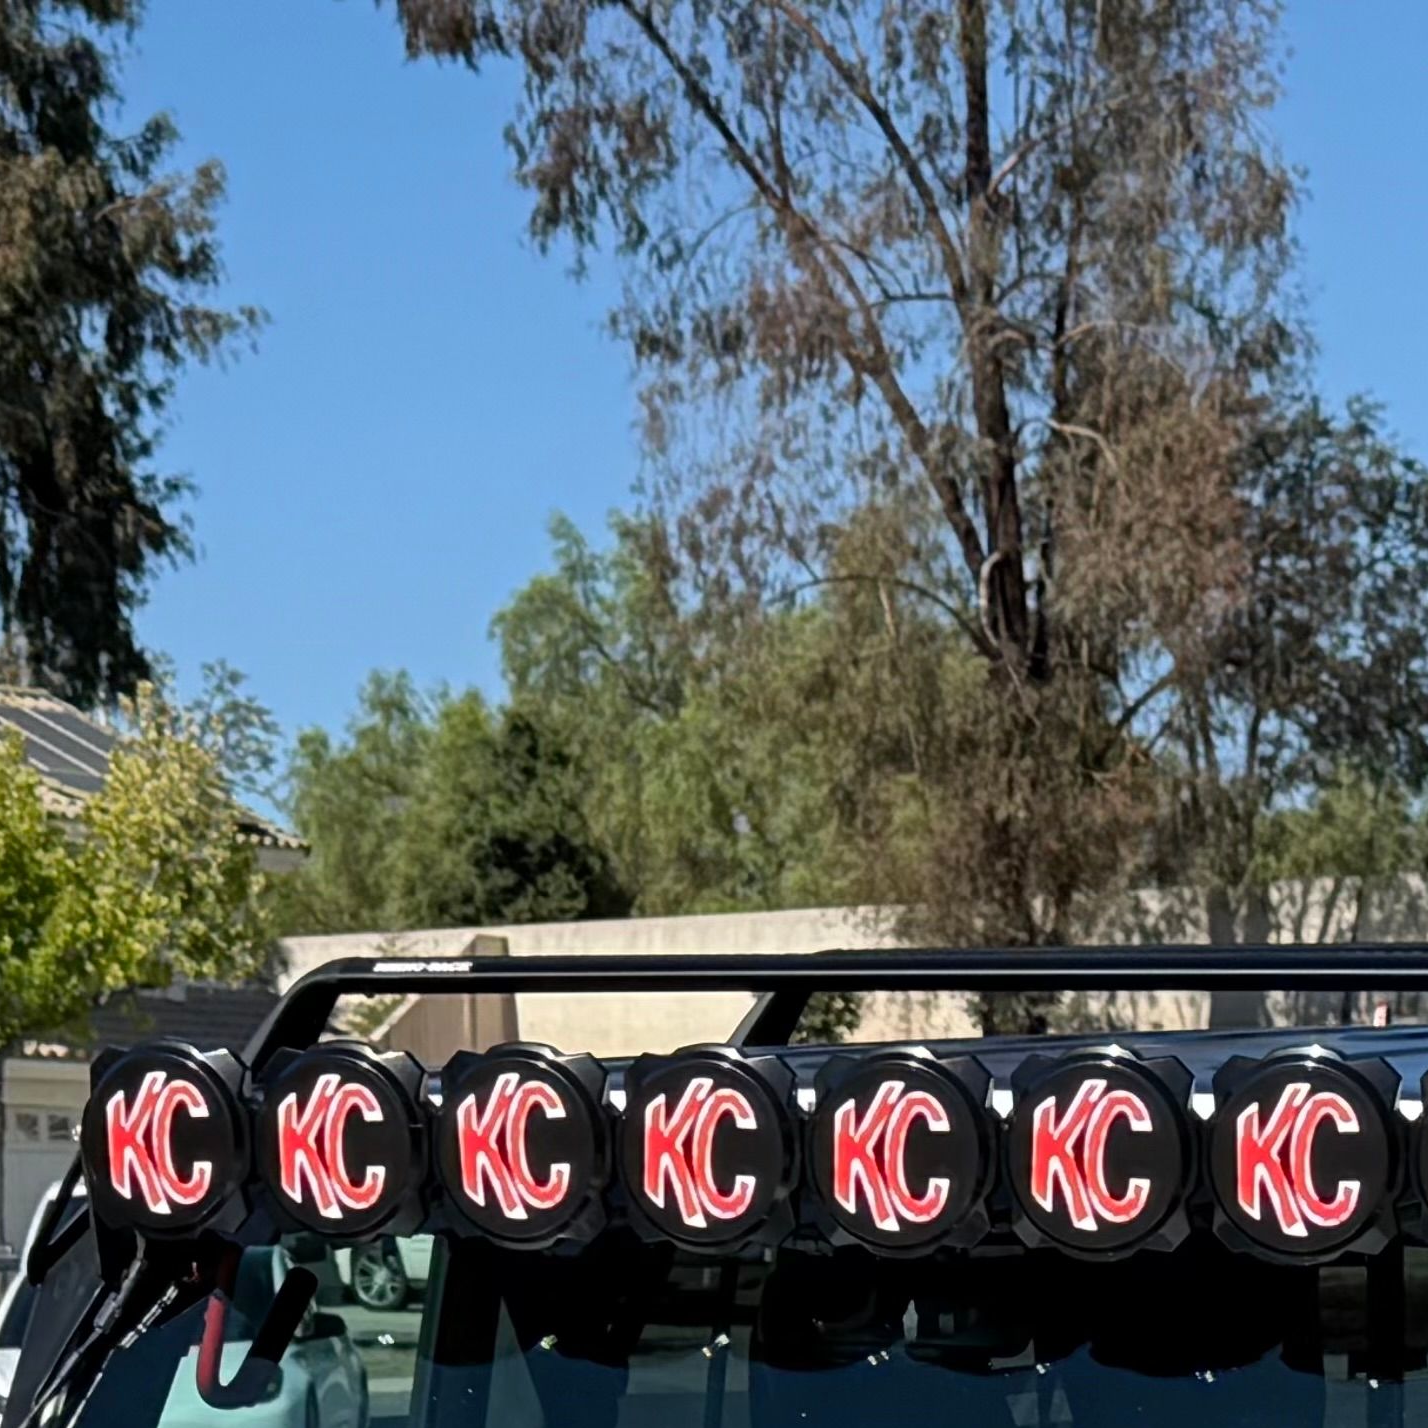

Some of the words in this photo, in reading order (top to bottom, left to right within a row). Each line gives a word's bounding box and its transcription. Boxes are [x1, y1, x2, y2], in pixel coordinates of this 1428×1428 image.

[105, 1070, 213, 1215] KC
[276, 1073, 387, 1220] KC
[455, 1071, 571, 1221] KC
[643, 1076, 758, 1229] KC
[833, 1079, 951, 1232] KC
[1030, 1078, 1154, 1232] KC
[1235, 1081, 1361, 1238] KC
